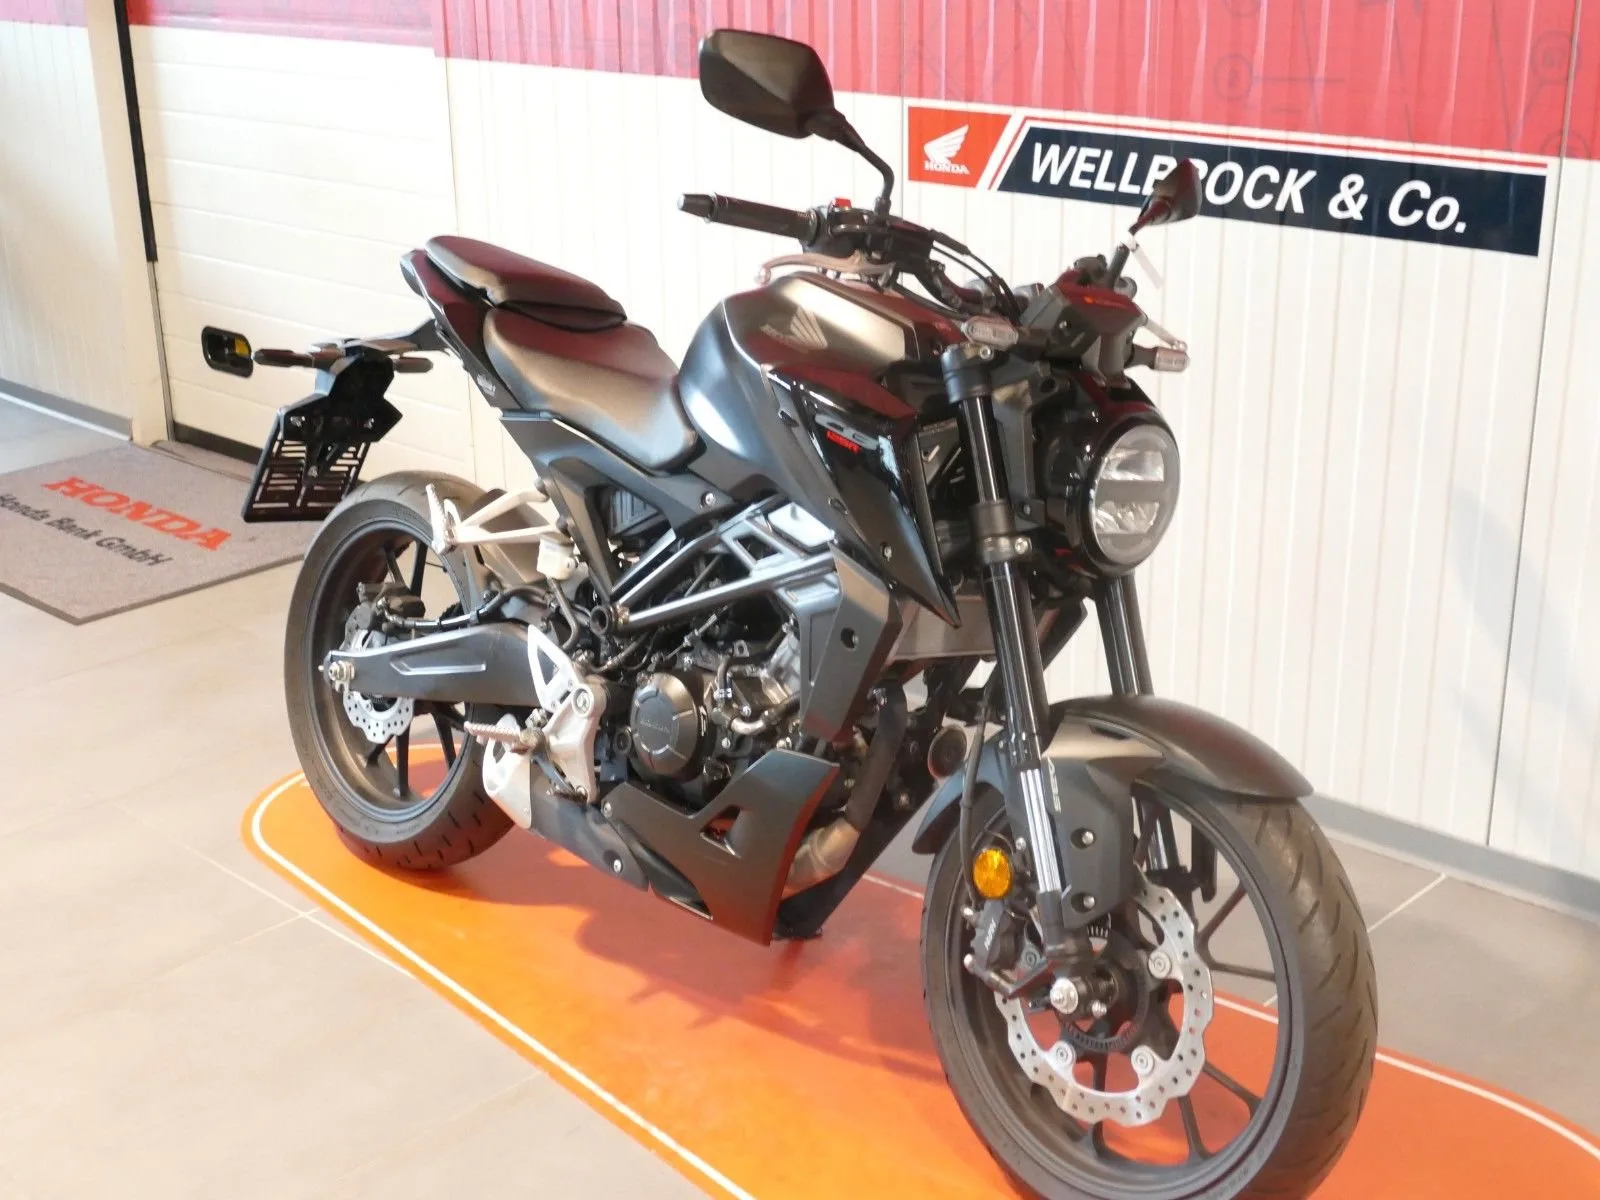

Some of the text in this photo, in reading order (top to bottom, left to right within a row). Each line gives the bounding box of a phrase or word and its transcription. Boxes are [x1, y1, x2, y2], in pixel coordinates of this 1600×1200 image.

[924, 160, 970, 175] HONDA
[1328, 173, 1368, 221] &
[1388, 179, 1467, 234] Co.
[41, 475, 232, 551] HONDA
